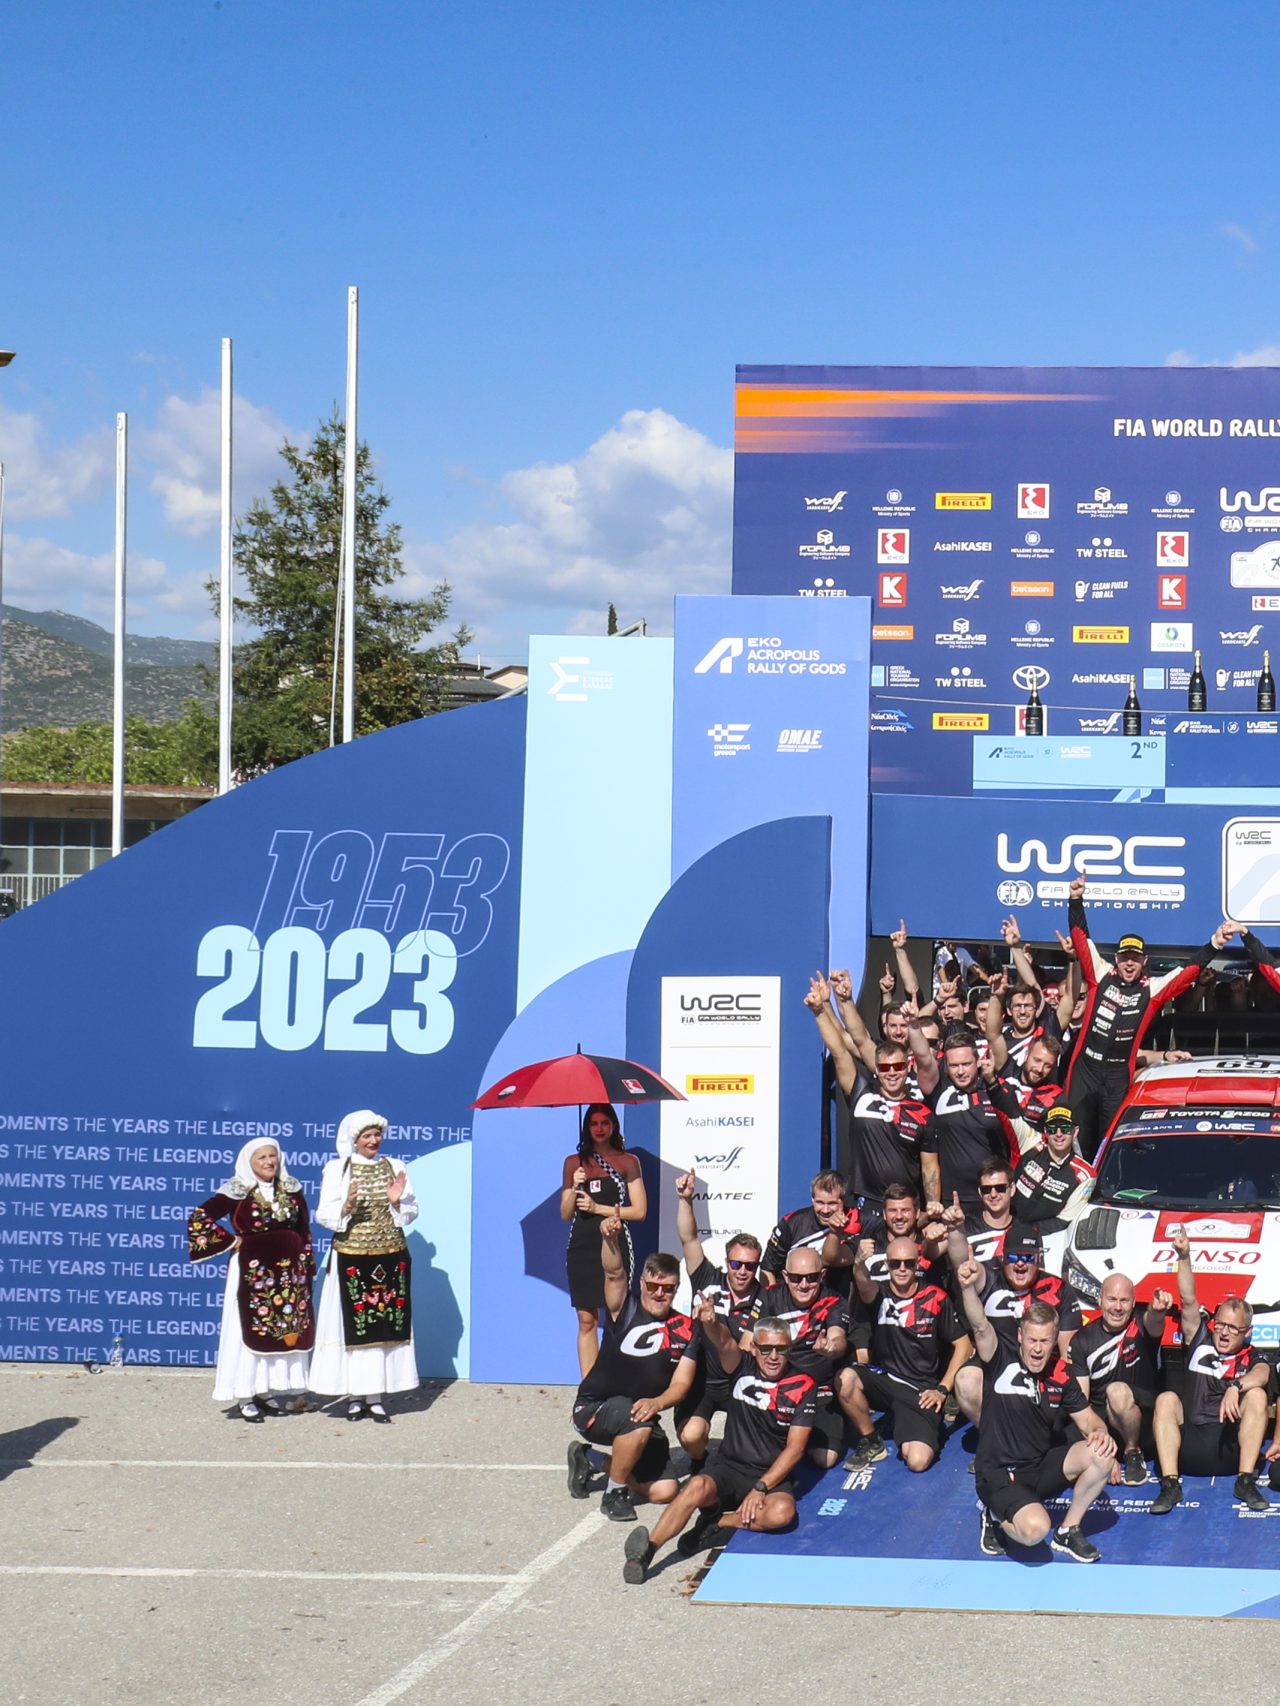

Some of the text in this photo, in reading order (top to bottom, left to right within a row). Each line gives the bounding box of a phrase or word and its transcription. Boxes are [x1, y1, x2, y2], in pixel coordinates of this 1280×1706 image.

[1114, 419, 1146, 437] FIA
[1151, 419, 1223, 437] WORLD
[941, 495, 986, 506] PIRELLI
[934, 541, 992, 551] AsahiKASEI
[1077, 549, 1128, 558] TW STEEL
[1012, 585, 1049, 593] betsson
[1079, 630, 1123, 640] PIRELLI
[748, 637, 782, 647] EKO
[748, 650, 820, 660] ACROPOLIS
[748, 663, 846, 674] RALLY OF GODS
[935, 678, 987, 687] TW STEEL
[939, 717, 983, 726] PIRELLI
[778, 729, 822, 745] OMAE
[1235, 831, 1271, 840] WRC
[997, 833, 1186, 876] WRC
[248, 830, 510, 958] 1953
[1042, 886, 1064, 894] FIA
[1084, 887, 1123, 895] ORLD
[1041, 901, 1180, 910] CHMPIONSHIP
[193, 924, 458, 1055] 2023
[681, 994, 761, 1011] WRC
[692, 1078, 749, 1091] PIRELLI
[686, 1117, 754, 1126] AsahiKASEI
[1215, 1123, 1255, 1131] WRC
[74, 1117, 106, 1133] THE
[112, 1118, 169, 1134] YEARS
[175, 1120, 207, 1135] THE
[212, 1121, 293, 1137] LEGENDS
[303, 1123, 336, 1138] THE
[437, 1126, 470, 1142] THE
[14, 1144, 234, 1164] THE YEARS THE LEGENDS
[692, 1192, 753, 1200] ANATEC
[12, 1202, 146, 1220] THE YEARS THE
[1153, 1250, 1261, 1264] DNSO
[9, 1259, 227, 1279] THE YEARS THE LEGENDS
[7, 1317, 40, 1331] THE
[45, 1318, 103, 1333] YEARS
[109, 1319, 142, 1334] THE
[620, 1315, 693, 1357] GR
